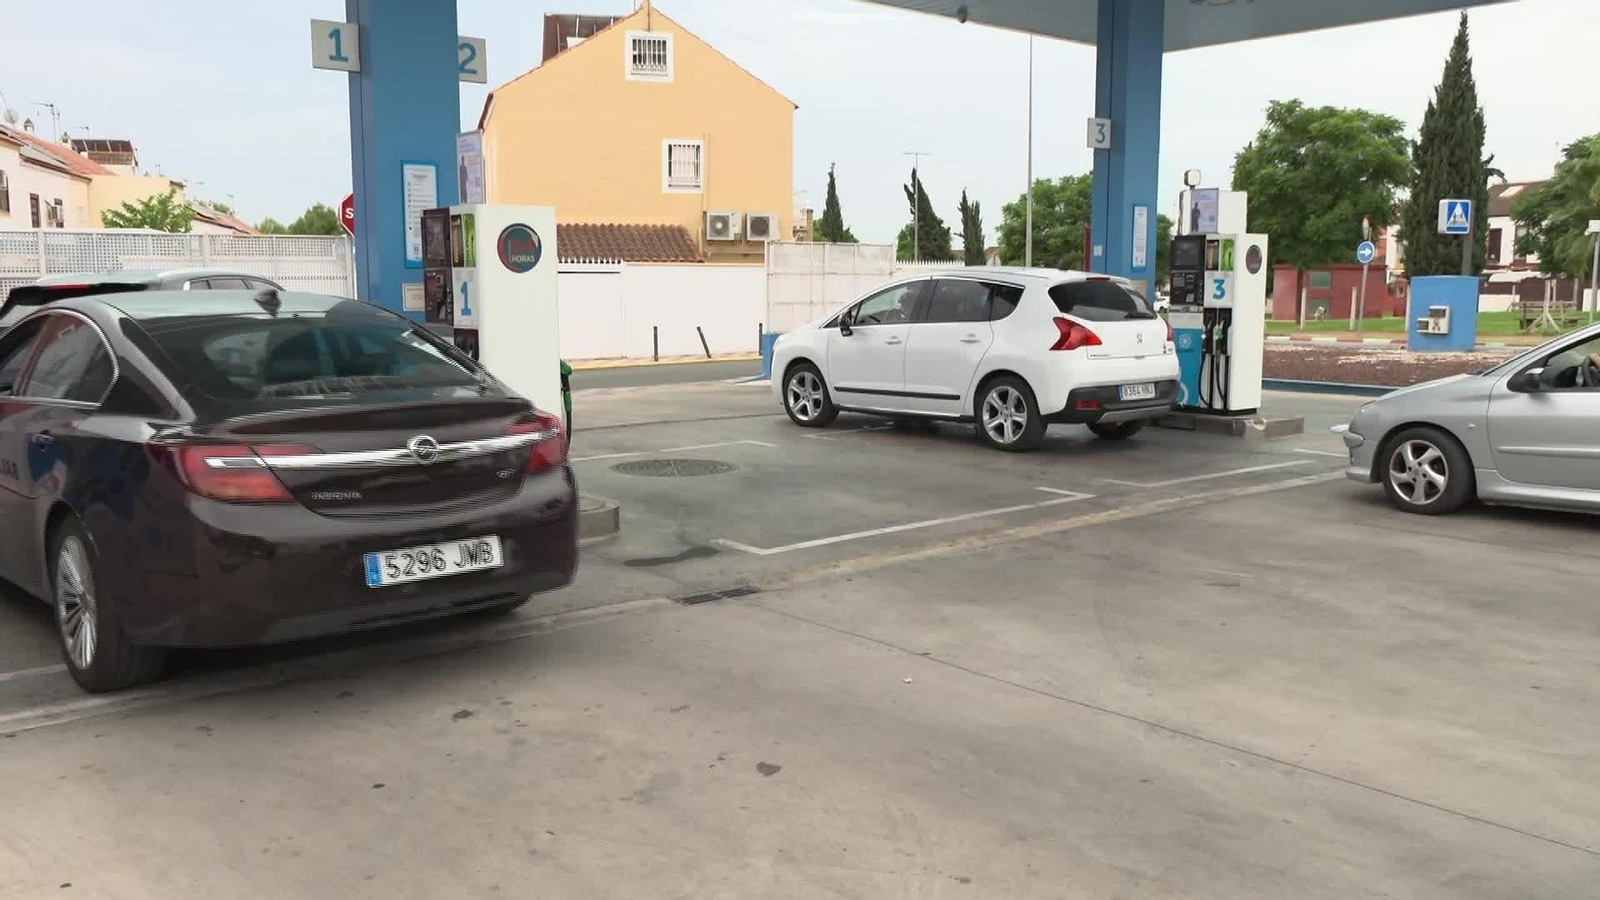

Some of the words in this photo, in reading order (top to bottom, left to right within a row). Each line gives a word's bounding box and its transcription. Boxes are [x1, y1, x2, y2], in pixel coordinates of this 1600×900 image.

[328, 28, 348, 62] 1
[458, 43, 477, 74] 2
[1095, 123, 1106, 145] 3
[460, 281, 472, 316] 1
[1213, 279, 1226, 299] 3
[385, 549, 446, 578] 5296
